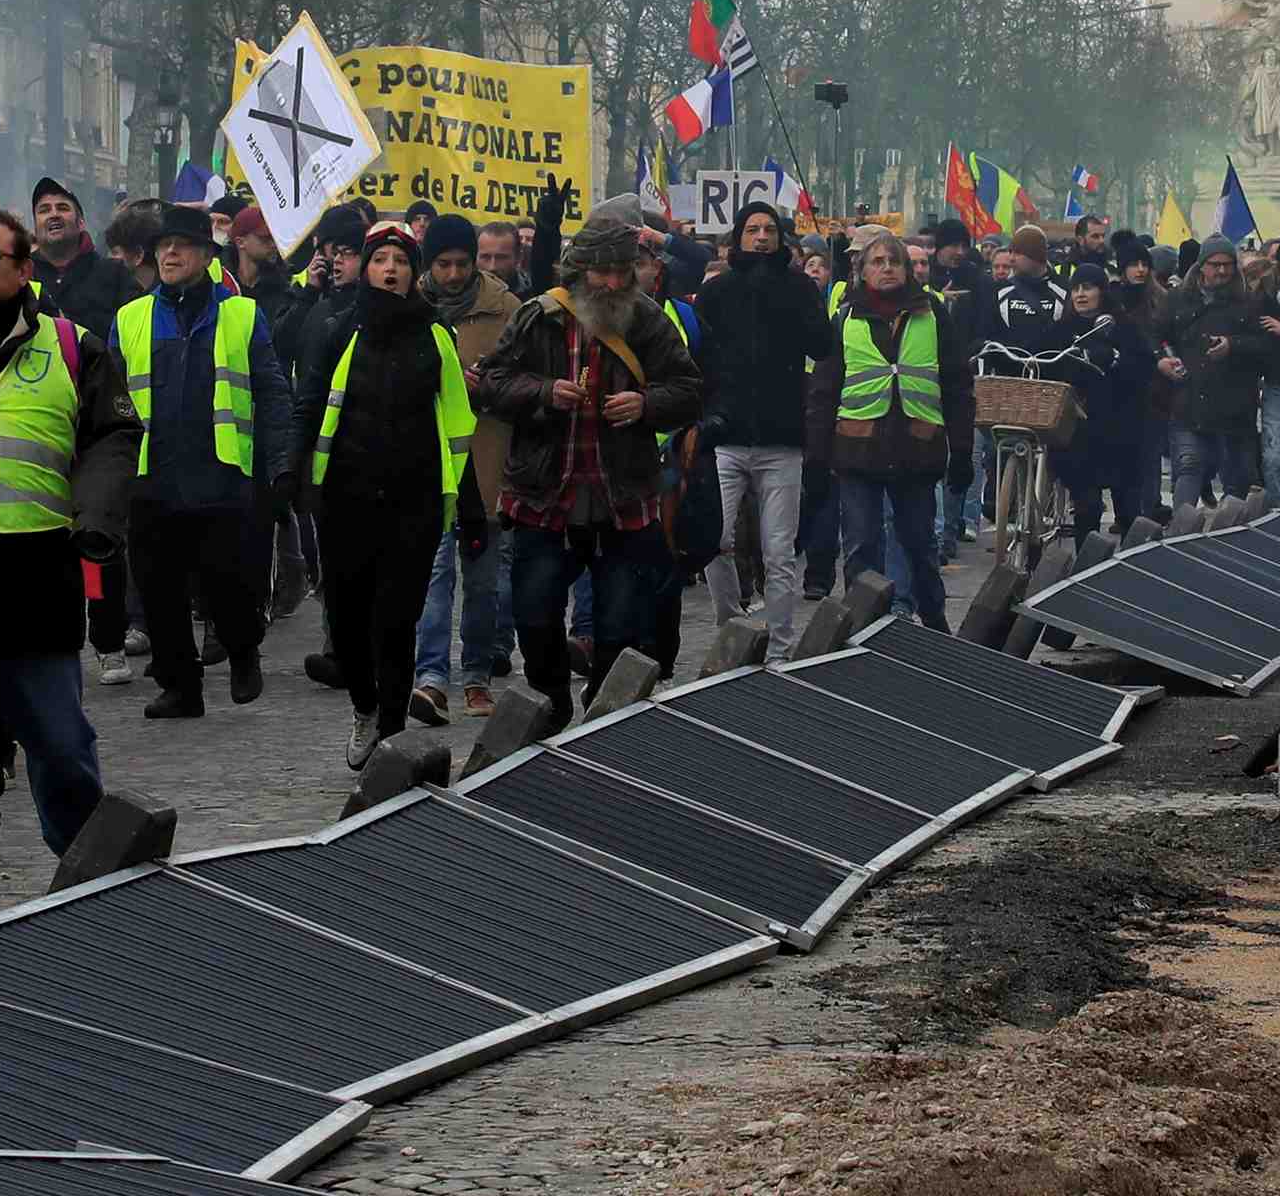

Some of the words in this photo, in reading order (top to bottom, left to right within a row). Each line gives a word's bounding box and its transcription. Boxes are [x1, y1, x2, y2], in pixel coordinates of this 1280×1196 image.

[376, 63, 467, 95] pour
[469, 74, 509, 104] une
[384, 110, 562, 164] NATIONALE
[411, 167, 444, 203] de
[450, 173, 478, 210] la
[484, 179, 583, 220] DETE
